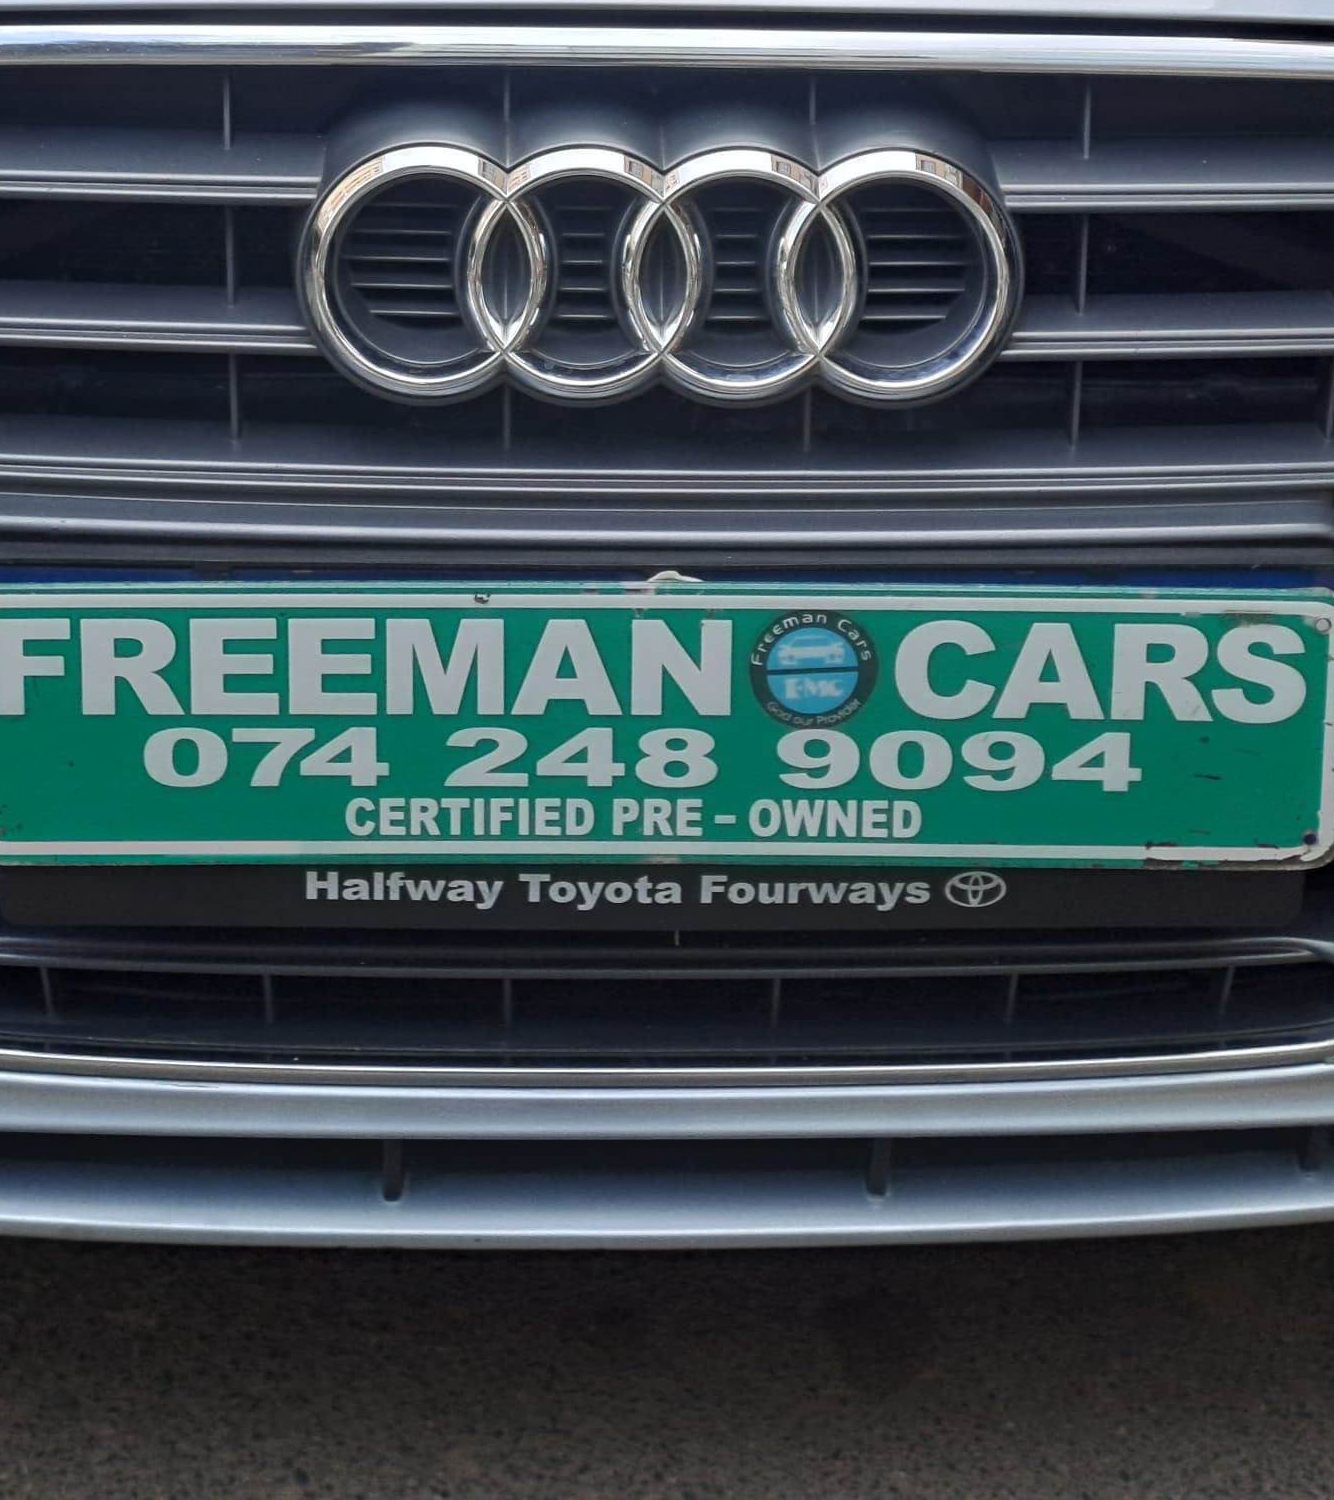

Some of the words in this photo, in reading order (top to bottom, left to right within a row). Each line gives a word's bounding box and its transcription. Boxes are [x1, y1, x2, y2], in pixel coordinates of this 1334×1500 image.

[750, 613, 828, 667] Freeman
[836, 618, 873, 661] Cars
[894, 620, 1308, 725] CARS
[144, 727, 389, 788] 074
[444, 727, 719, 788] 248
[776, 729, 1142, 792] 9094
[345, 797, 595, 836] CERTIFIED
[612, 798, 703, 837] PRE
[748, 799, 923, 838] OWNED
[305, 871, 504, 910] Halfway
[519, 873, 682, 911] Toyota
[700, 875, 931, 912] Fourways
